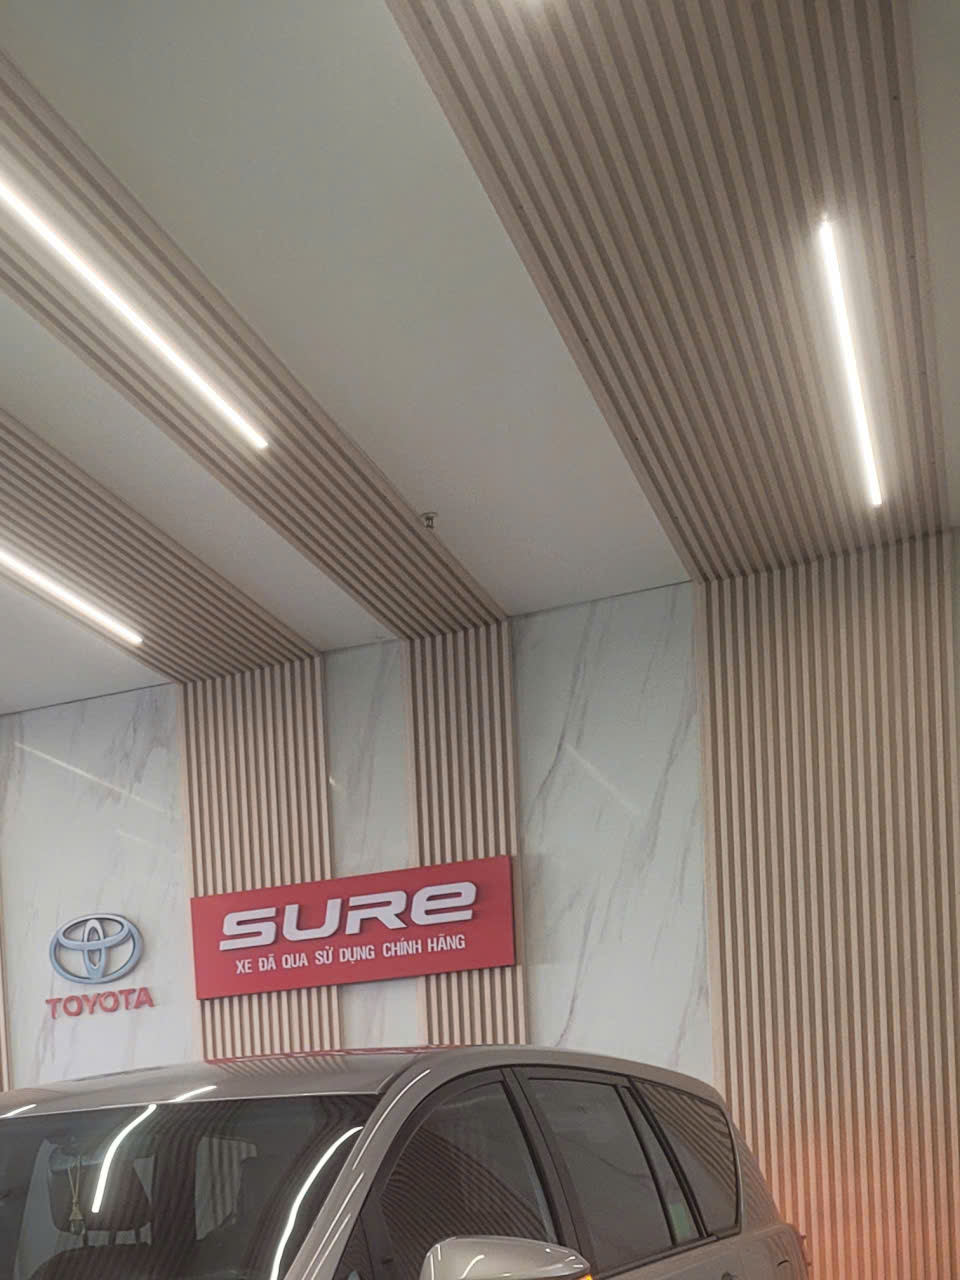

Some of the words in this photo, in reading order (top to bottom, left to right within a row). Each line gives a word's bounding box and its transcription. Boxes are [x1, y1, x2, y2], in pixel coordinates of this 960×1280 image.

[235, 958, 253, 975] XE
[258, 953, 277, 972] ĐÃ
[282, 953, 309, 969] QUA
[315, 945, 334, 965] SỬ
[339, 945, 376, 965] DỤNG
[382, 937, 423, 958] CHÍNH
[427, 933, 466, 953] HÃNG
[45, 987, 155, 1020] TOYOTA
